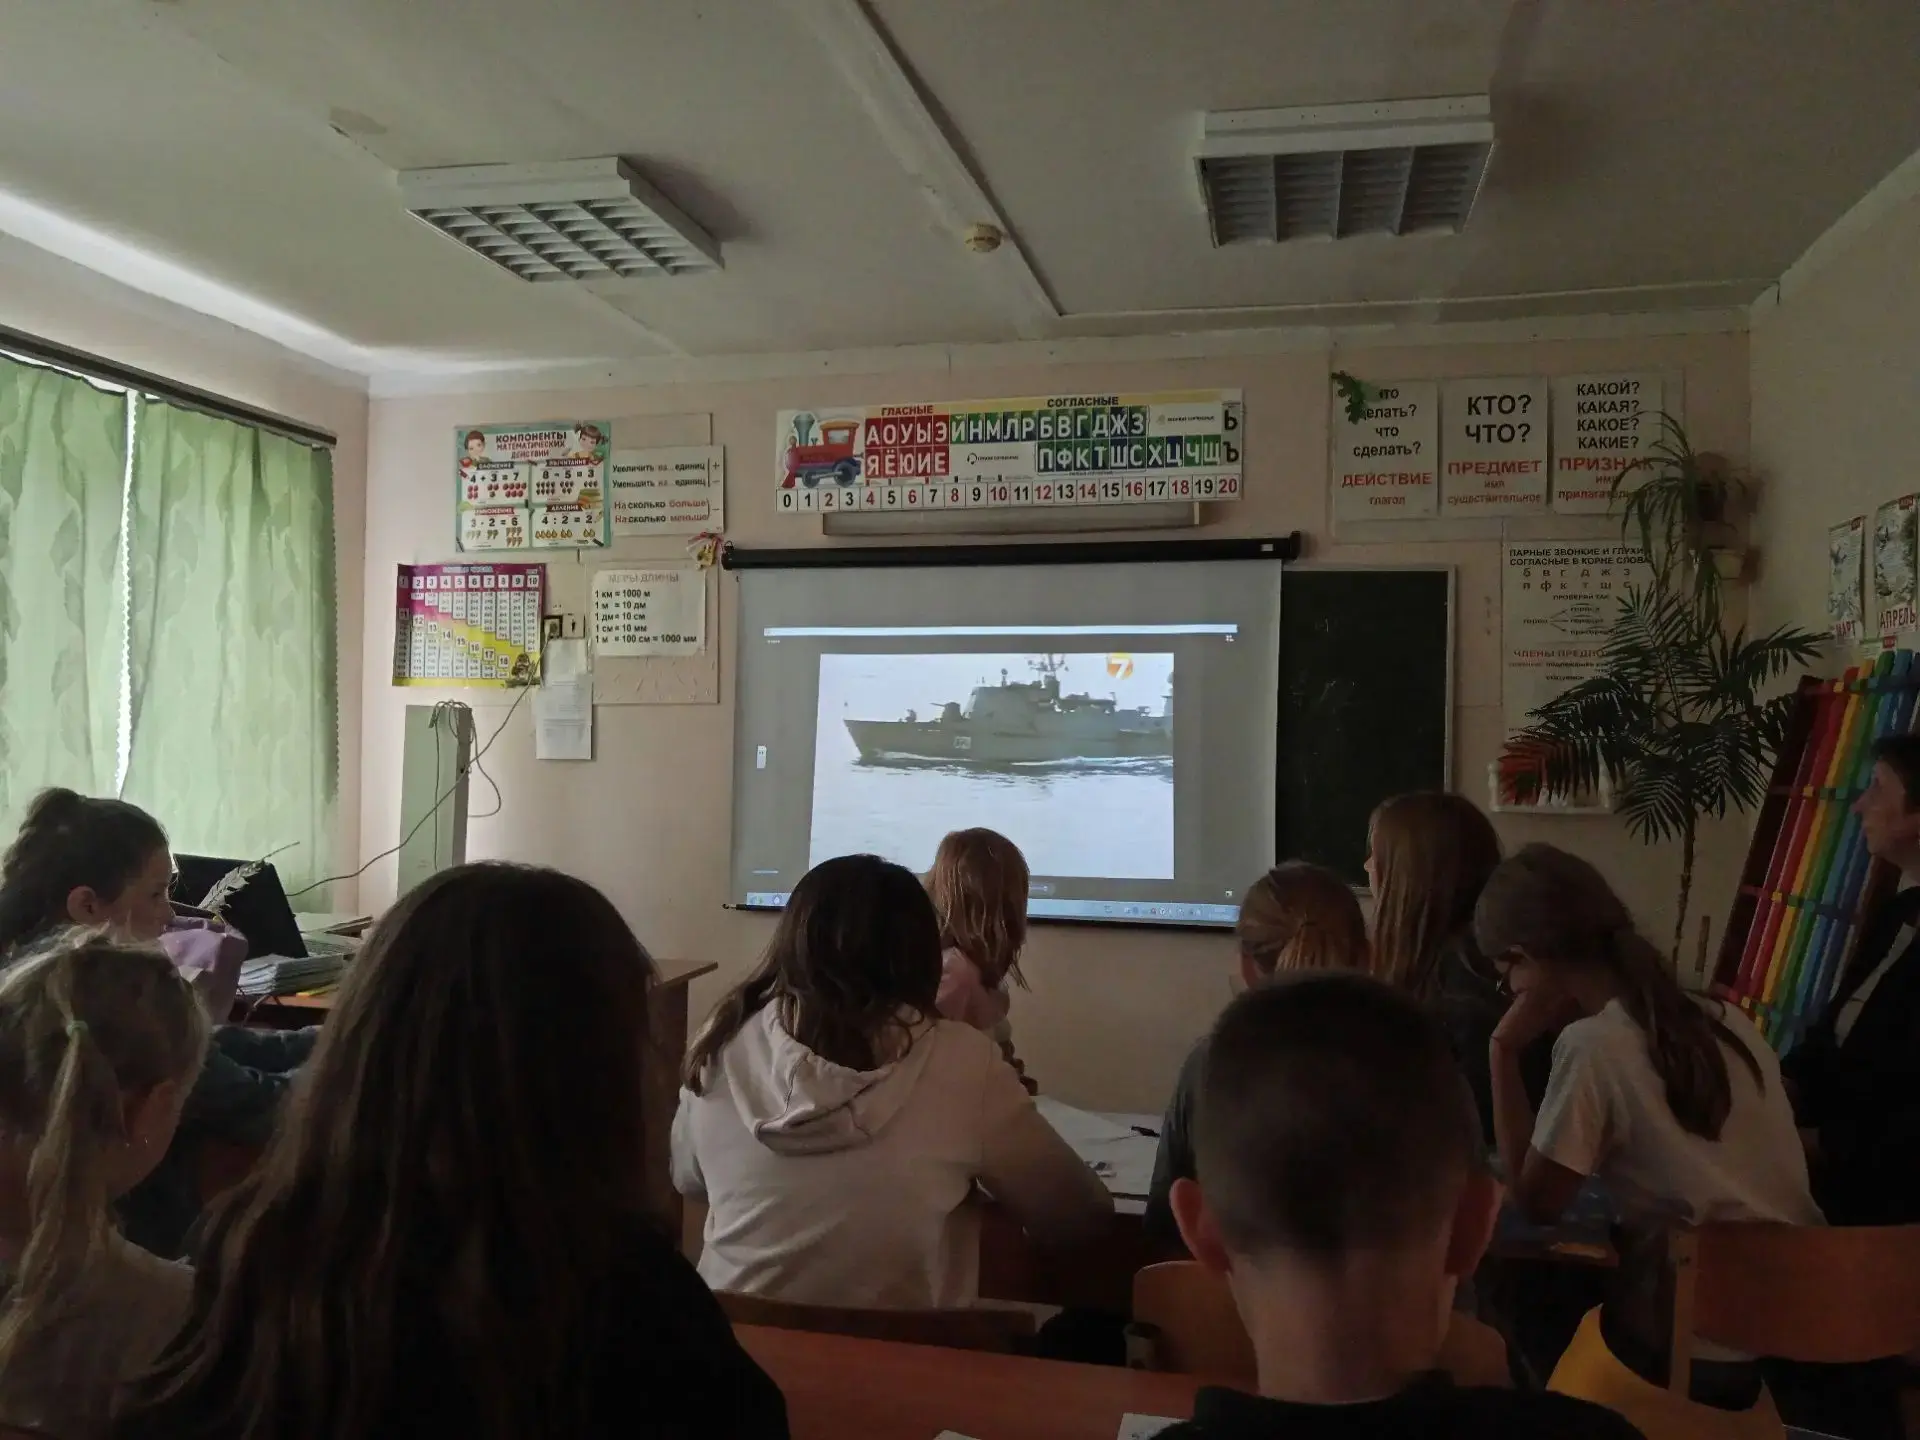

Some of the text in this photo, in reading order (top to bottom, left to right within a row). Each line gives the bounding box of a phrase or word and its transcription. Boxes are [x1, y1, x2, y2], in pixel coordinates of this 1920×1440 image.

[1577, 378, 1640, 396] КАКОЙ?
[1047, 396, 1119, 408] СОГЛАСНЫЕ
[1467, 394, 1531, 416] КТО?
[1577, 400, 1640, 414] КАКАЯ?
[880, 405, 934, 417] ГЛАСНЫЕ
[1363, 404, 1417, 420] елать?
[1577, 417, 1640, 432] КАКОЕ?
[496, 432, 566, 443] КОМПОНЕНТЫ
[1375, 427, 1399, 437] что
[1465, 423, 1531, 443] ЧТО?
[497, 441, 566, 452] МАТЕМАТИЧЕСКИХ
[1578, 436, 1639, 449] КАКИЕ?
[1353, 441, 1421, 459] сделать?
[612, 463, 655, 473] Увеличить
[675, 463, 706, 472] единиц
[1447, 460, 1542, 476] ПРЕДМЕТ
[612, 479, 655, 490] Уменьшить
[675, 478, 706, 488] единиц
[1341, 472, 1433, 488] ДЕЙСТВИЕ
[783, 478, 1237, 508] 0 1 2 3 4 5 6 7 8 9 10 11 12 13 14 15 16 17 18 19 20
[669, 499, 707, 508] больше
[1369, 496, 1405, 506] глагол
[670, 513, 707, 522] меньше
[1510, 547, 1644, 558] ПАРНЫЕ ЗВОНКИЕ И ГЛУХИ
[1510, 557, 1571, 566] СОГЛАСНЫЕ
[1582, 556, 1614, 565] КОРНЕ
[529, 577, 538, 585] 10
[640, 572, 679, 583] ДЛИНЫ
[1540, 580, 1551, 592] ф
[622, 589, 641, 598] 1000
[622, 601, 632, 609] 10
[633, 602, 647, 610] дм
[415, 616, 423, 624] 12
[601, 613, 614, 622] дм
[622, 612, 632, 620] 10
[1880, 607, 1916, 629] АПРЕЛЬ
[429, 623, 437, 631] 13
[622, 624, 632, 632] 10
[443, 631, 451, 639] 14
[622, 635, 637, 643] 100
[661, 634, 681, 643] 1000
[683, 635, 697, 643] мм
[485, 650, 494, 658] 17
[1112, 658, 1129, 679] 7
